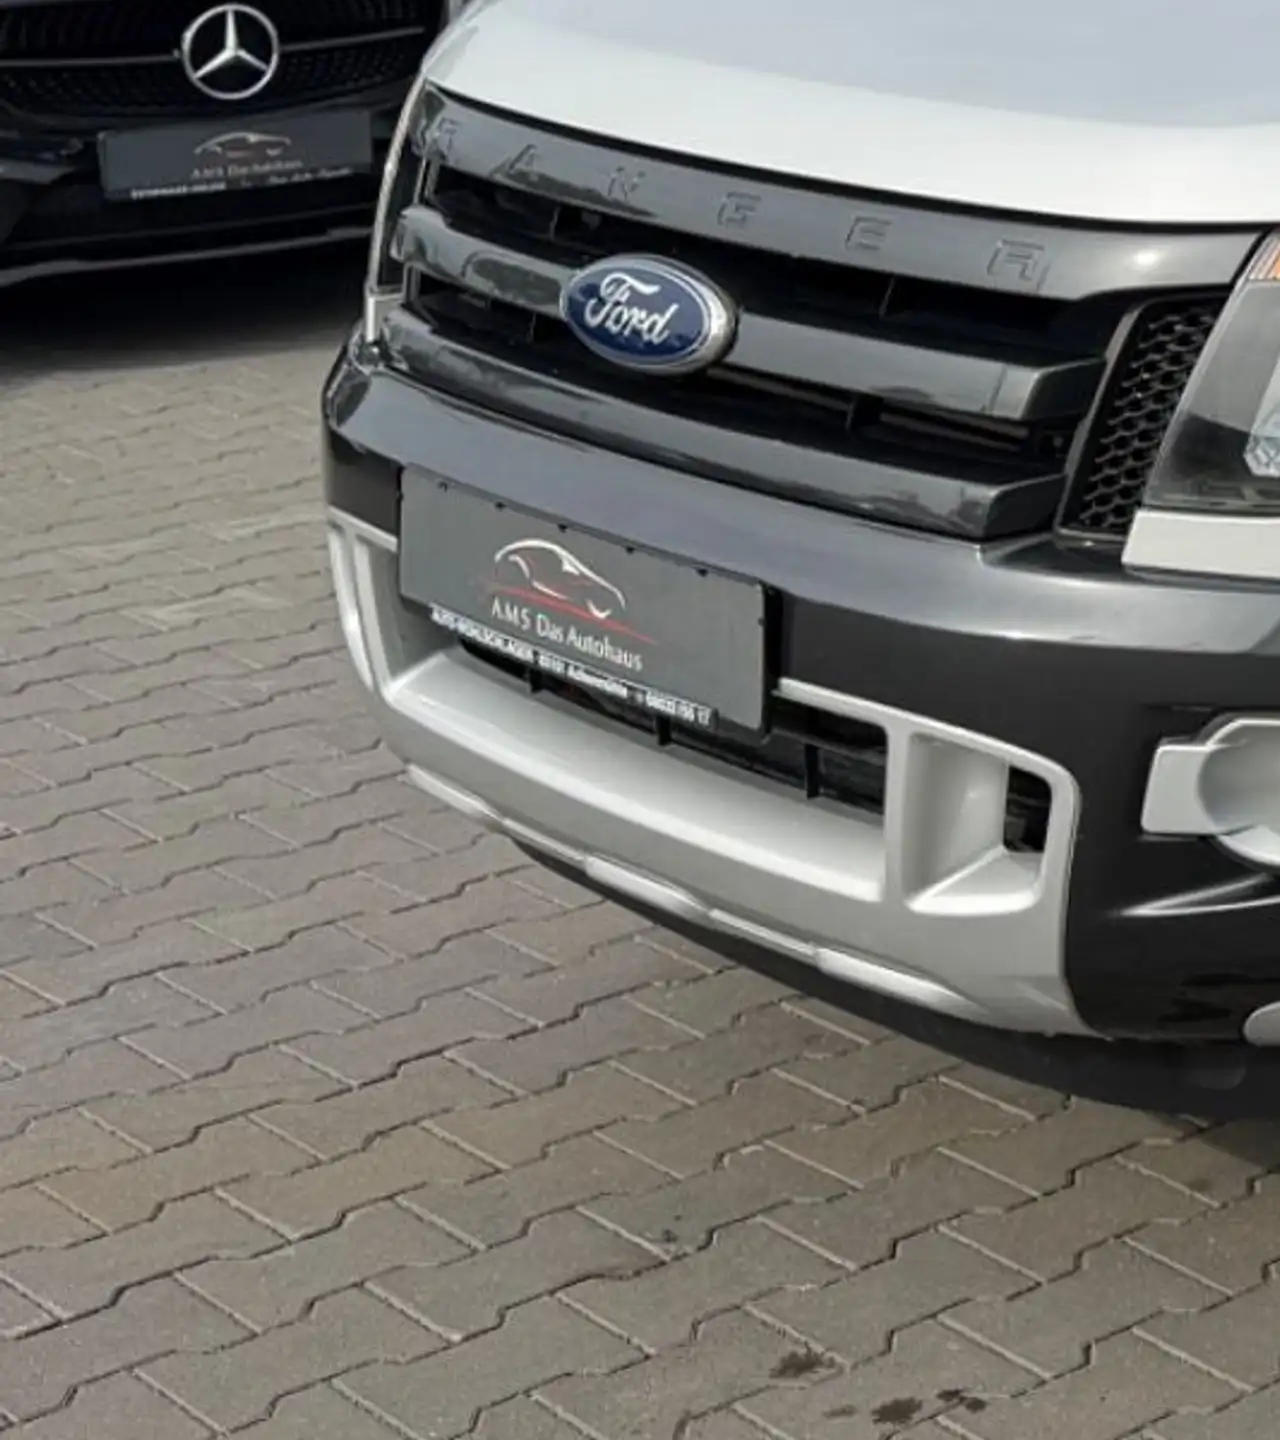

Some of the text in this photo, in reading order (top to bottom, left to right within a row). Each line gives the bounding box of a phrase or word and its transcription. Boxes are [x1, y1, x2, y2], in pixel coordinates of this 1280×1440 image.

[428, 116, 1048, 290] RANGER
[584, 272, 680, 346] Ford
[491, 596, 644, 672] AMS Das Autohaus
